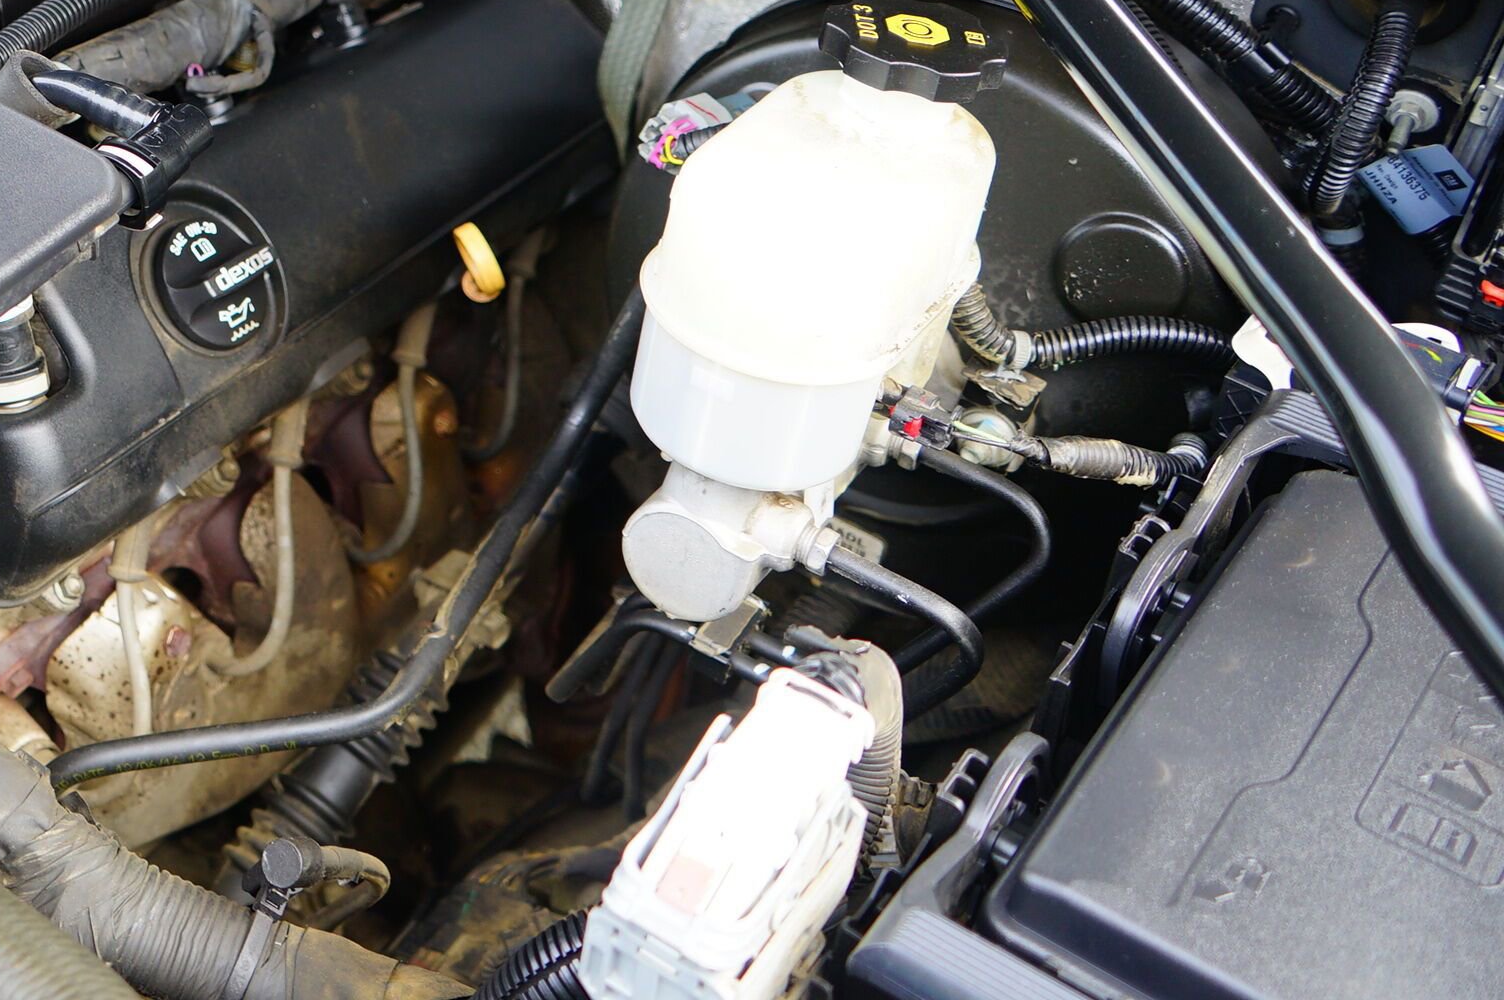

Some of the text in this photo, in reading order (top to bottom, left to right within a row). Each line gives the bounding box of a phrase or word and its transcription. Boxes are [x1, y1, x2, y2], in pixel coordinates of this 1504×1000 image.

[852, 4, 879, 40] DOT 3
[169, 232, 188, 257] SAE
[215, 246, 274, 291] dexos
